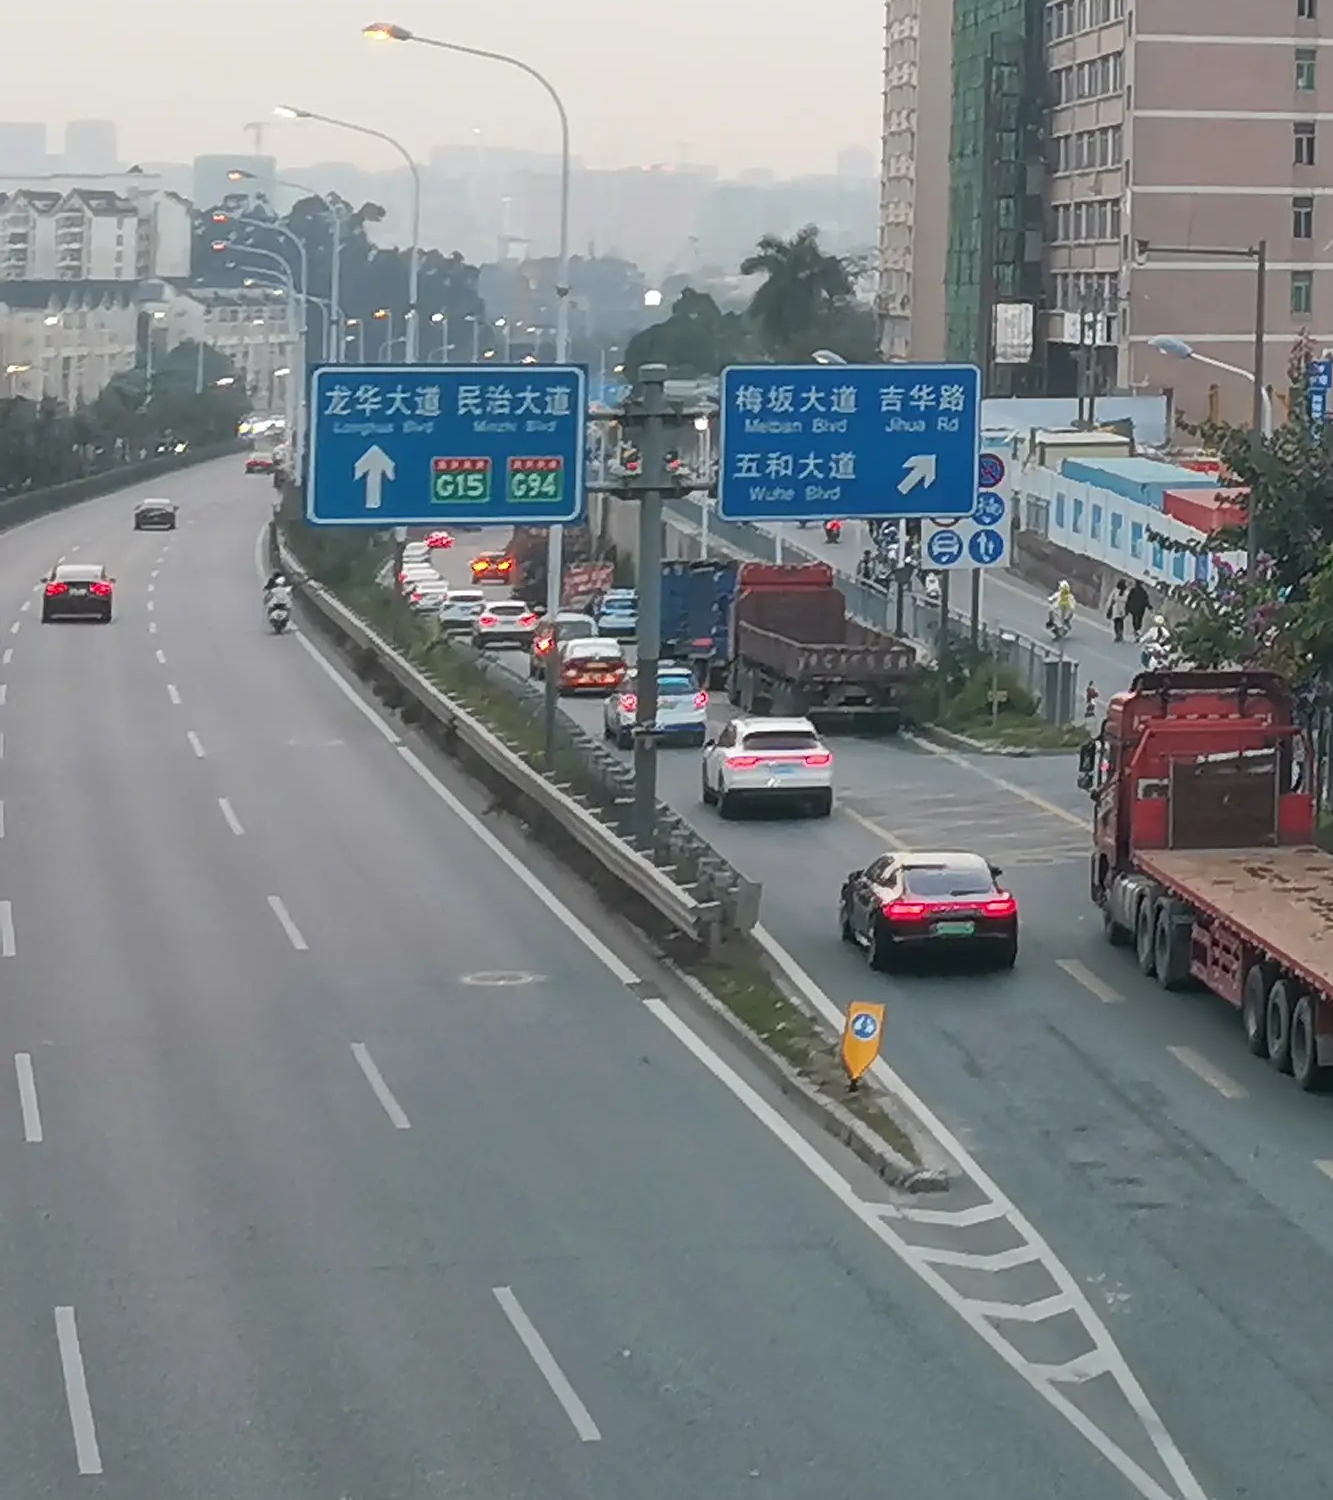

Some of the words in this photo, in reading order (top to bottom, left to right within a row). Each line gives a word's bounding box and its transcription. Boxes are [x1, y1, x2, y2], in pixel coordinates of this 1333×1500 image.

[324, 385, 442, 416] 龙华大道
[457, 385, 573, 416] 民治大道
[735, 384, 858, 414] 梅坂大道
[879, 384, 966, 412] 吉华路
[937, 417, 959, 432] Rd
[732, 451, 856, 479] 五和大道
[436, 474, 484, 497] G15
[511, 474, 557, 497] G94
[805, 486, 841, 500] Blvd
